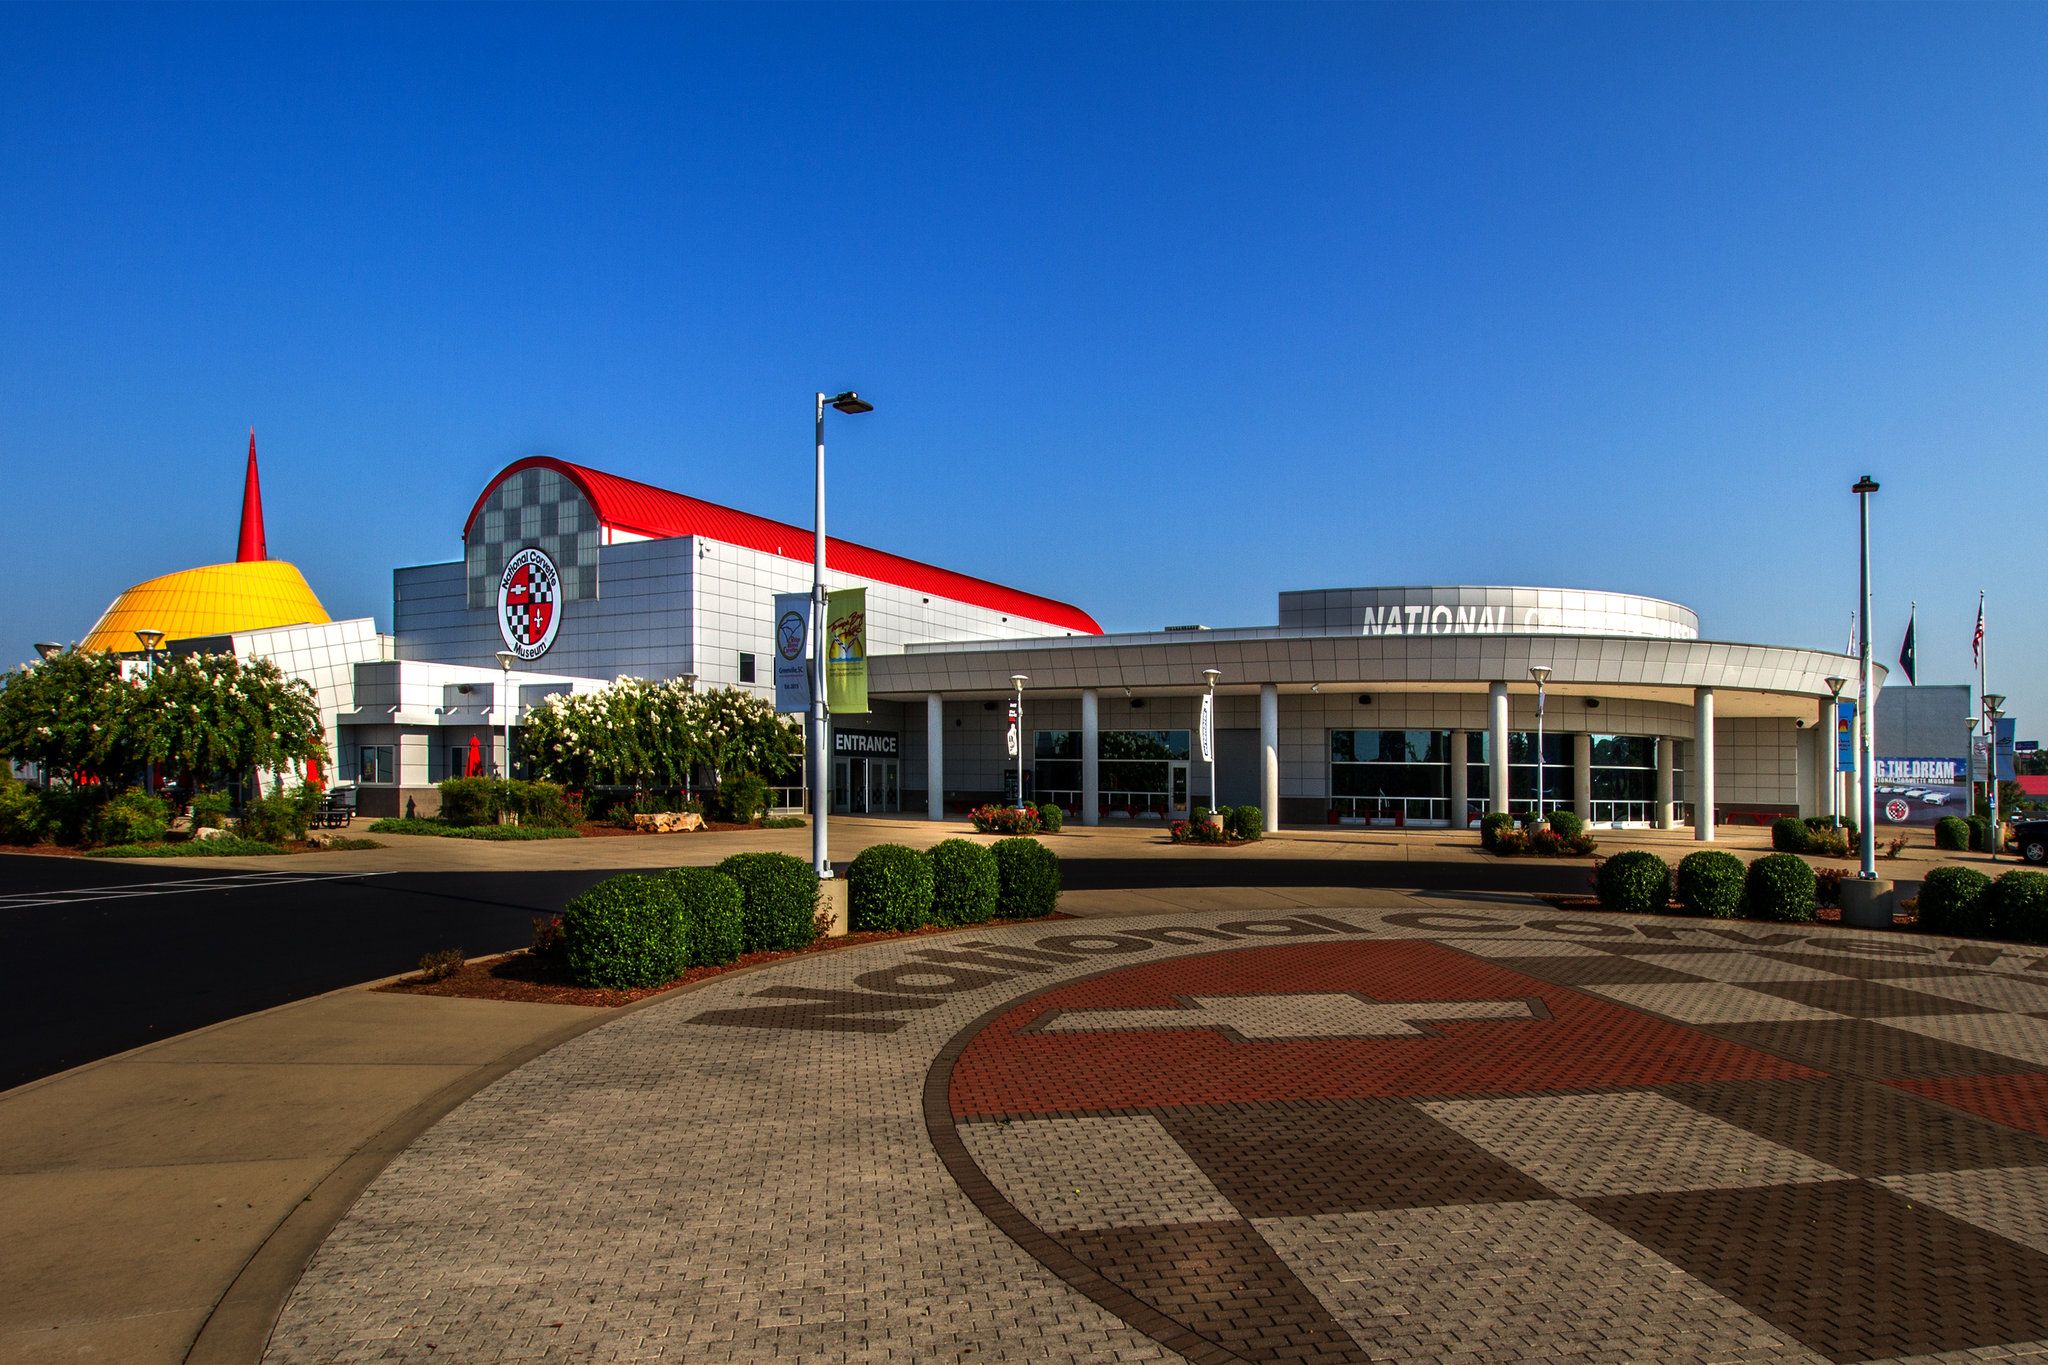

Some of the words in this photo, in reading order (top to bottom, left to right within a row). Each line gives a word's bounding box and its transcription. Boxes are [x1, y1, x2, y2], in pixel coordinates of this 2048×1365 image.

[502, 552, 528, 590] National
[530, 551, 557, 587] Corvette
[514, 641, 547, 658] Museum
[835, 733, 896, 753] ENTRANCE
[1888, 761, 1911, 778] THE
[1912, 760, 1955, 779] DREAM
[684, 912, 1374, 1033] National
